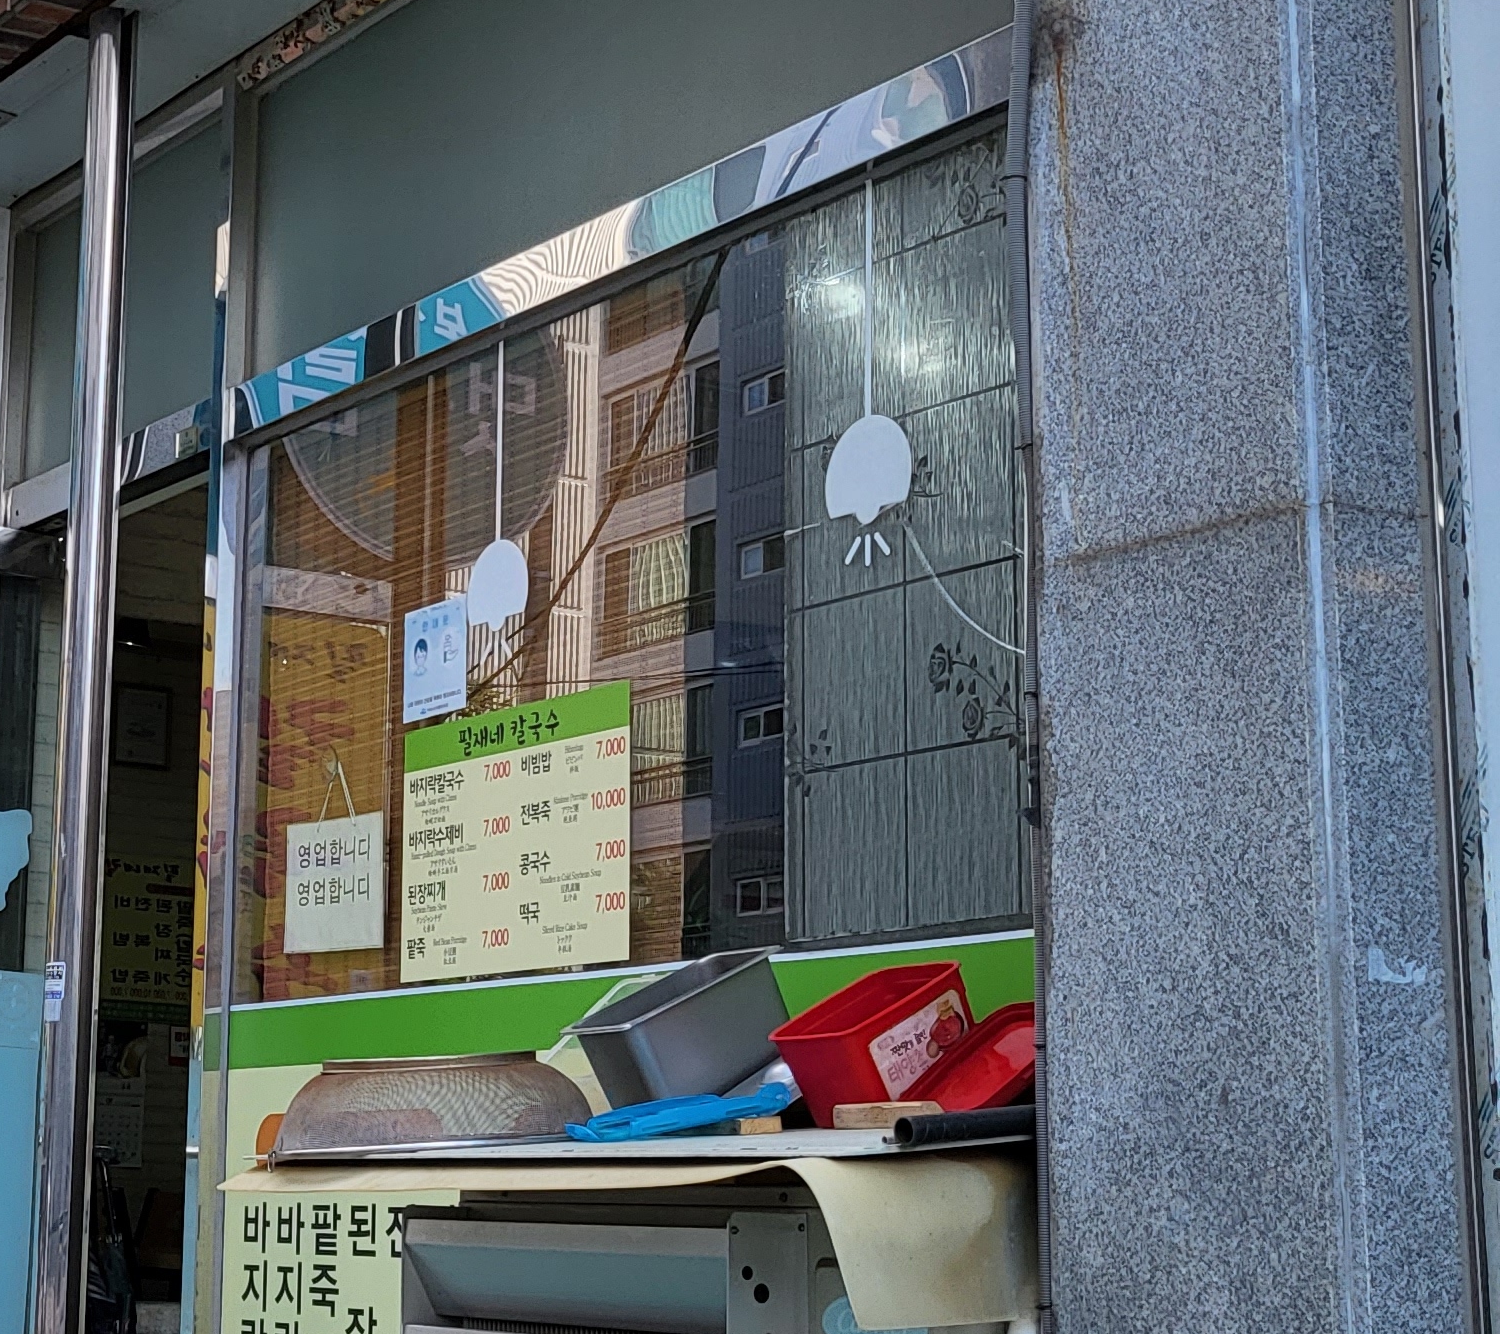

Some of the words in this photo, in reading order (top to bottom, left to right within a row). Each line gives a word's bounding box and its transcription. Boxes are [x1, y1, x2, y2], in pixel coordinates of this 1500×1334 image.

[458, 723, 505, 756] 필재네
[510, 711, 560, 747] 칼국수
[521, 750, 552, 776] 비빔밥
[596, 736, 626, 760] 7,000
[409, 769, 465, 799] 바지락칼국수
[484, 760, 511, 782] 7,000
[520, 800, 551, 826] 전복죽
[591, 787, 626, 811] 10,000
[297, 832, 371, 869] 영업합니다
[409, 822, 464, 851] 바지락수제비
[483, 815, 510, 838] 7,000
[596, 839, 626, 862] 7,000
[519, 850, 551, 876] 콩국수
[297, 872, 371, 908] 영업합니다
[408, 880, 446, 905] 된장찌개
[483, 872, 510, 893] 7,000
[519, 902, 540, 925] 떡국
[596, 891, 626, 914] 7,000
[407, 937, 426, 960] 팥죽
[482, 928, 509, 949] 7,000
